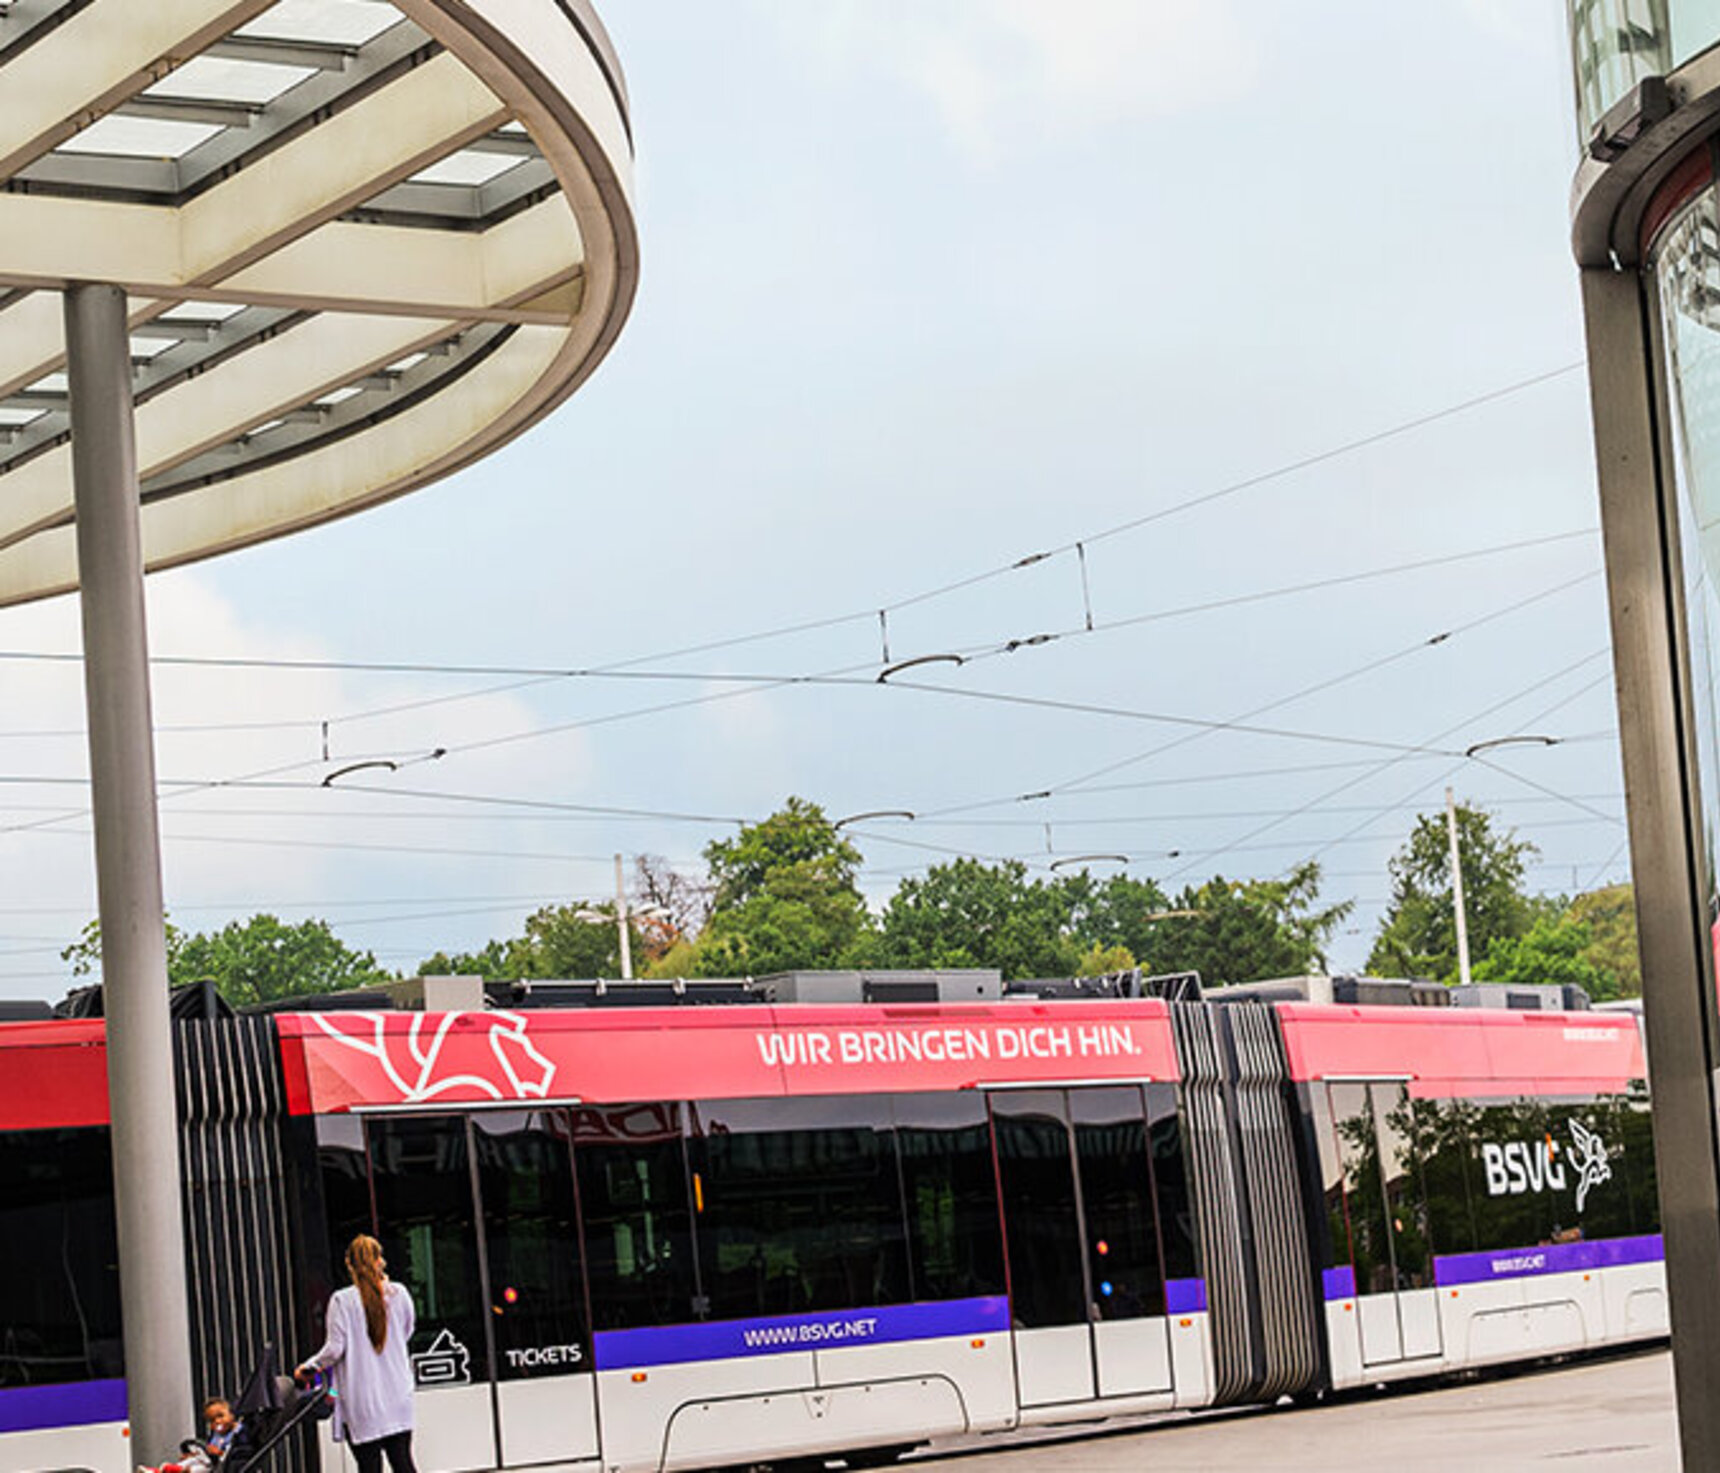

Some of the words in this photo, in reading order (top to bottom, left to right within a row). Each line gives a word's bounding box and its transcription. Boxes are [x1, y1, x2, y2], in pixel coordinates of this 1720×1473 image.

[756, 1032, 832, 1066] WIR
[837, 1029, 991, 1064] BRINGEN
[995, 1026, 1071, 1059] DICH
[1078, 1025, 1142, 1056] HIN.
[1482, 1139, 1567, 1196] BSVG
[743, 1317, 878, 1348] WWW.BSVG.NET
[505, 1342, 583, 1368] TICKETS
